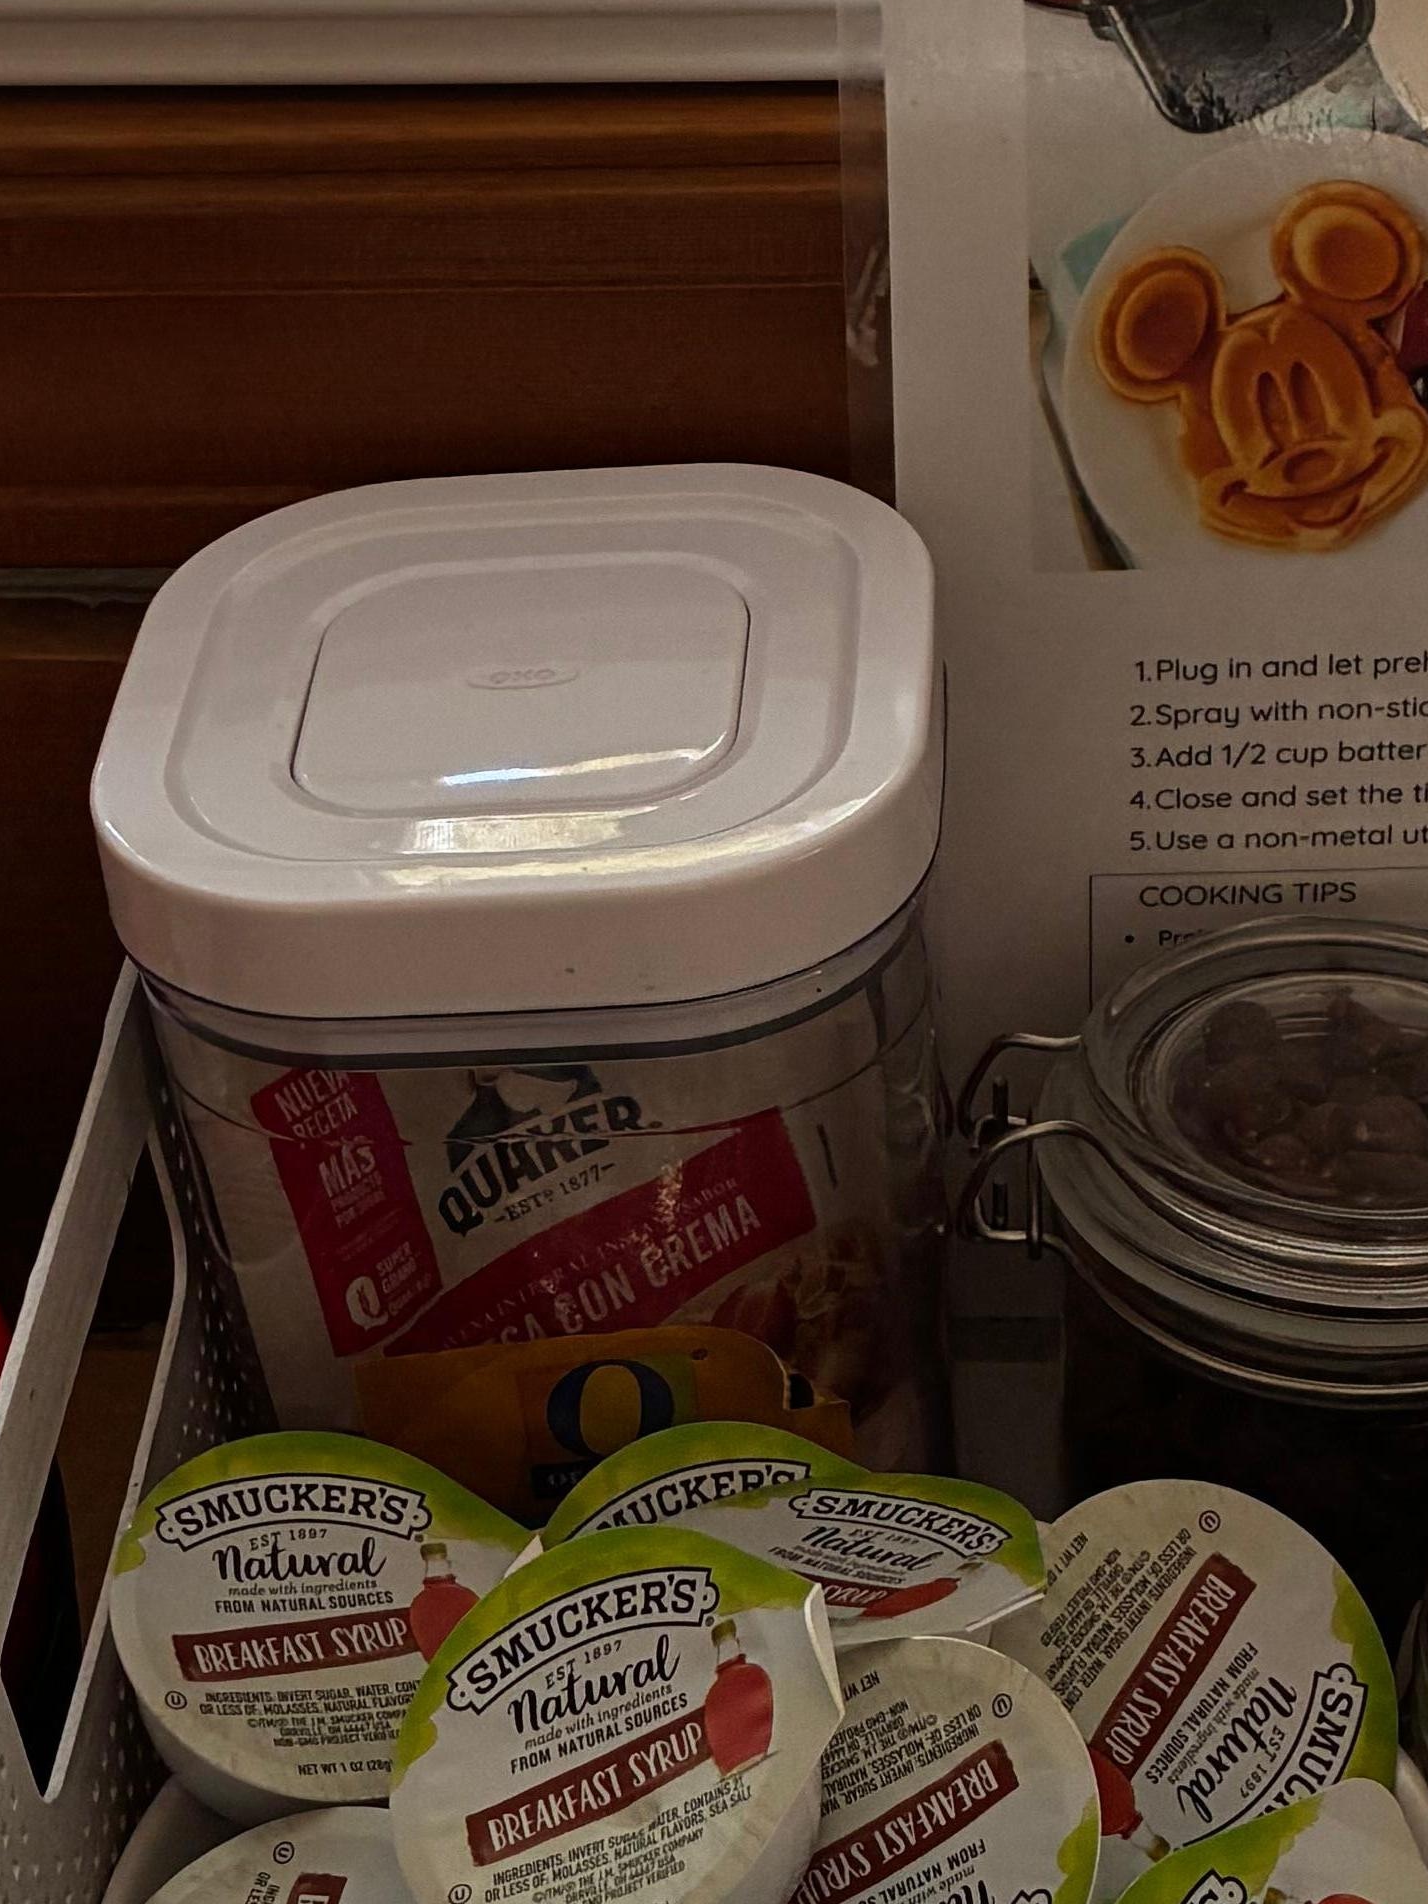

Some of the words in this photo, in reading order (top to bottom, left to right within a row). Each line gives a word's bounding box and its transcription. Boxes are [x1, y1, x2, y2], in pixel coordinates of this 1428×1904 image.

[1228, 657, 1252, 680] in
[1261, 653, 1318, 678] and
[1328, 652, 1364, 677] let
[1249, 698, 1308, 723] with
[1221, 740, 1267, 769] 1/2
[1275, 746, 1329, 769] cup
[1337, 740, 1428, 763] batter
[1240, 783, 1297, 808] and
[1305, 785, 1349, 807] set
[1357, 783, 1404, 805] the
[1216, 833, 1235, 850] a
[1244, 823, 1393, 849] non-metal
[1138, 883, 1284, 908] COOKING
[1291, 881, 1357, 905] TIPS
[174, 1484, 409, 1536] SMUCKER'S
[812, 1497, 997, 1561] SMUCKER'S
[212, 1537, 386, 1582] Natural
[250, 1532, 280, 1551] EST
[289, 1529, 327, 1541] 1897
[801, 1526, 943, 1571] Natural
[216, 1600, 255, 1613] FROM
[261, 1596, 325, 1611] NATURAL
[329, 1592, 394, 1609] SOURCES
[193, 1632, 324, 1673] BREAKFAST
[330, 1618, 408, 1656] SYRUP
[466, 1574, 697, 1695] SMUCKER'S
[1145, 1573, 1237, 1699] BREAKFAST
[507, 1634, 680, 1734] Natural
[545, 1661, 576, 1690] EST
[584, 1640, 623, 1665] 1897
[511, 1747, 551, 1775] FROM
[558, 1723, 623, 1759] NATURAL
[626, 1694, 688, 1731] SOURCES
[525, 1728, 563, 1750] made
[565, 1713, 594, 1736] with
[598, 1684, 673, 1725] ingredients
[1106, 1688, 1162, 1765] SYRUP
[1176, 1677, 1297, 1824] Natural
[488, 1765, 623, 1852] BREAKFAST
[631, 1722, 703, 1788] SYRUP
[880, 1759, 999, 1865] BREAKFAST
